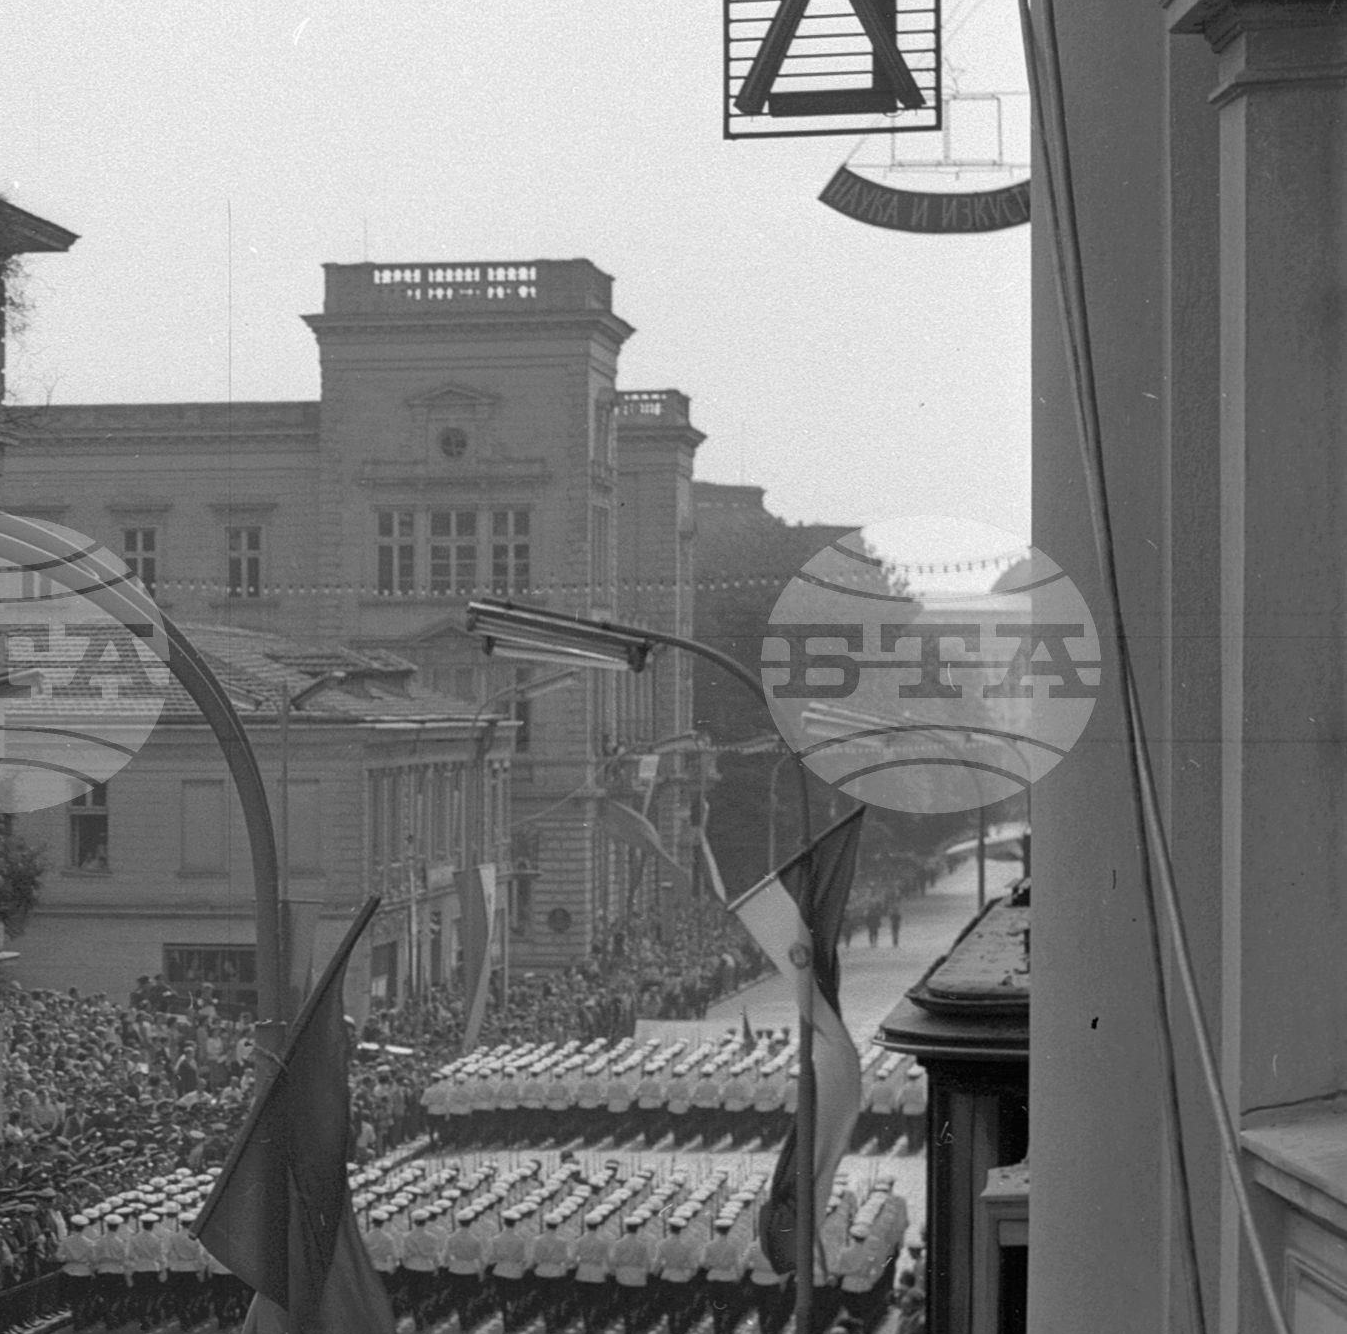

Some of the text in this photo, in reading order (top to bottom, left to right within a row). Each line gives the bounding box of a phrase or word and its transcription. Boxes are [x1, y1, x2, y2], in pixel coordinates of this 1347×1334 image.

[826, 172, 1031, 230] НАУКА И ИЗКУСТ
